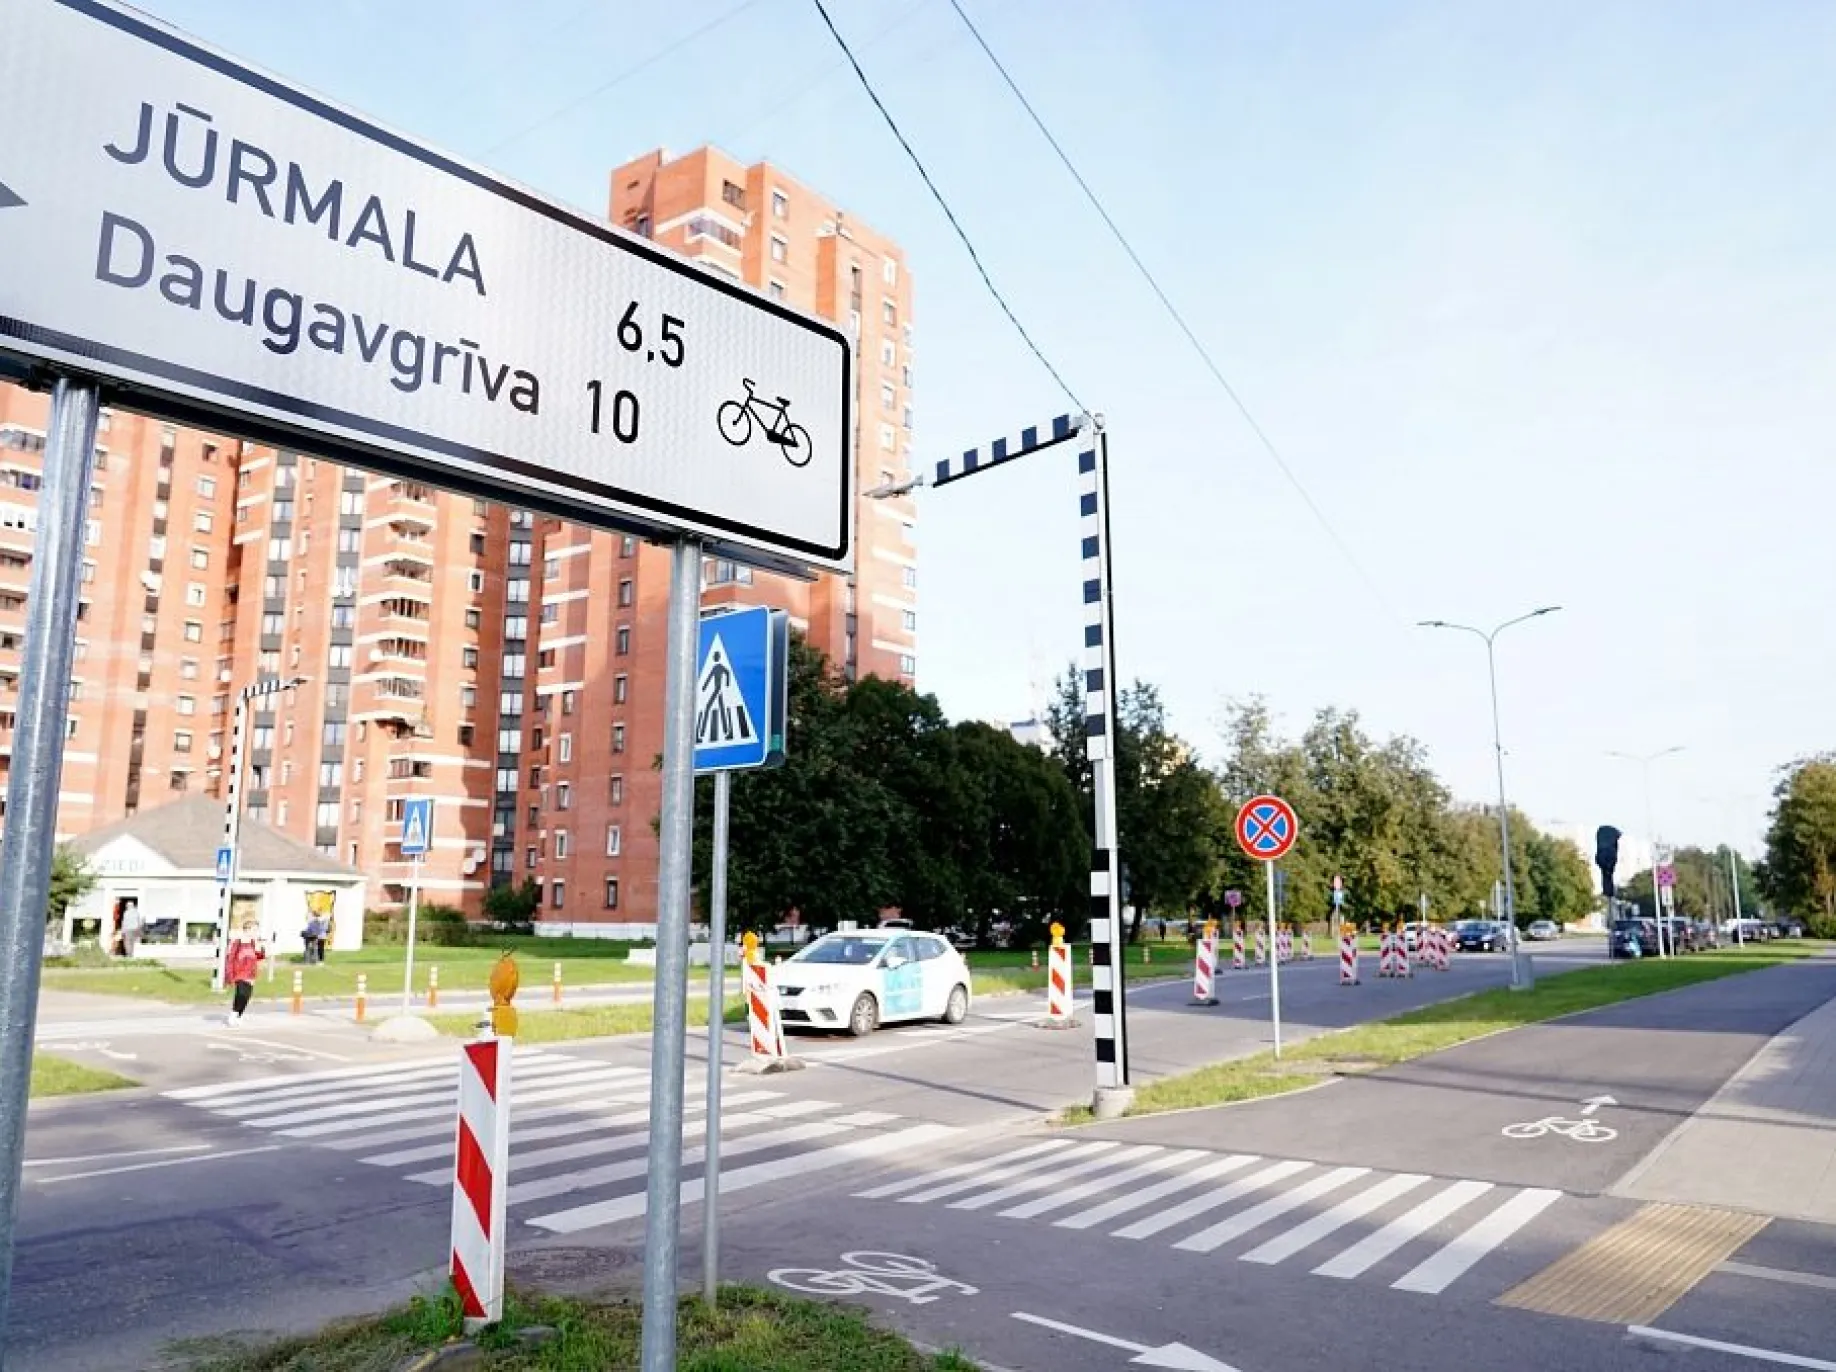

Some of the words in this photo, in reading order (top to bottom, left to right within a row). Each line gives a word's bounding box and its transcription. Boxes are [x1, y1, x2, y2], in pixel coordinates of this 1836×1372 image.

[96, 212, 540, 414] Daugavgrīva
[586, 380, 639, 443] 10
[104, 102, 486, 295] JŪRMALA
[617, 301, 685, 367] 6,5
